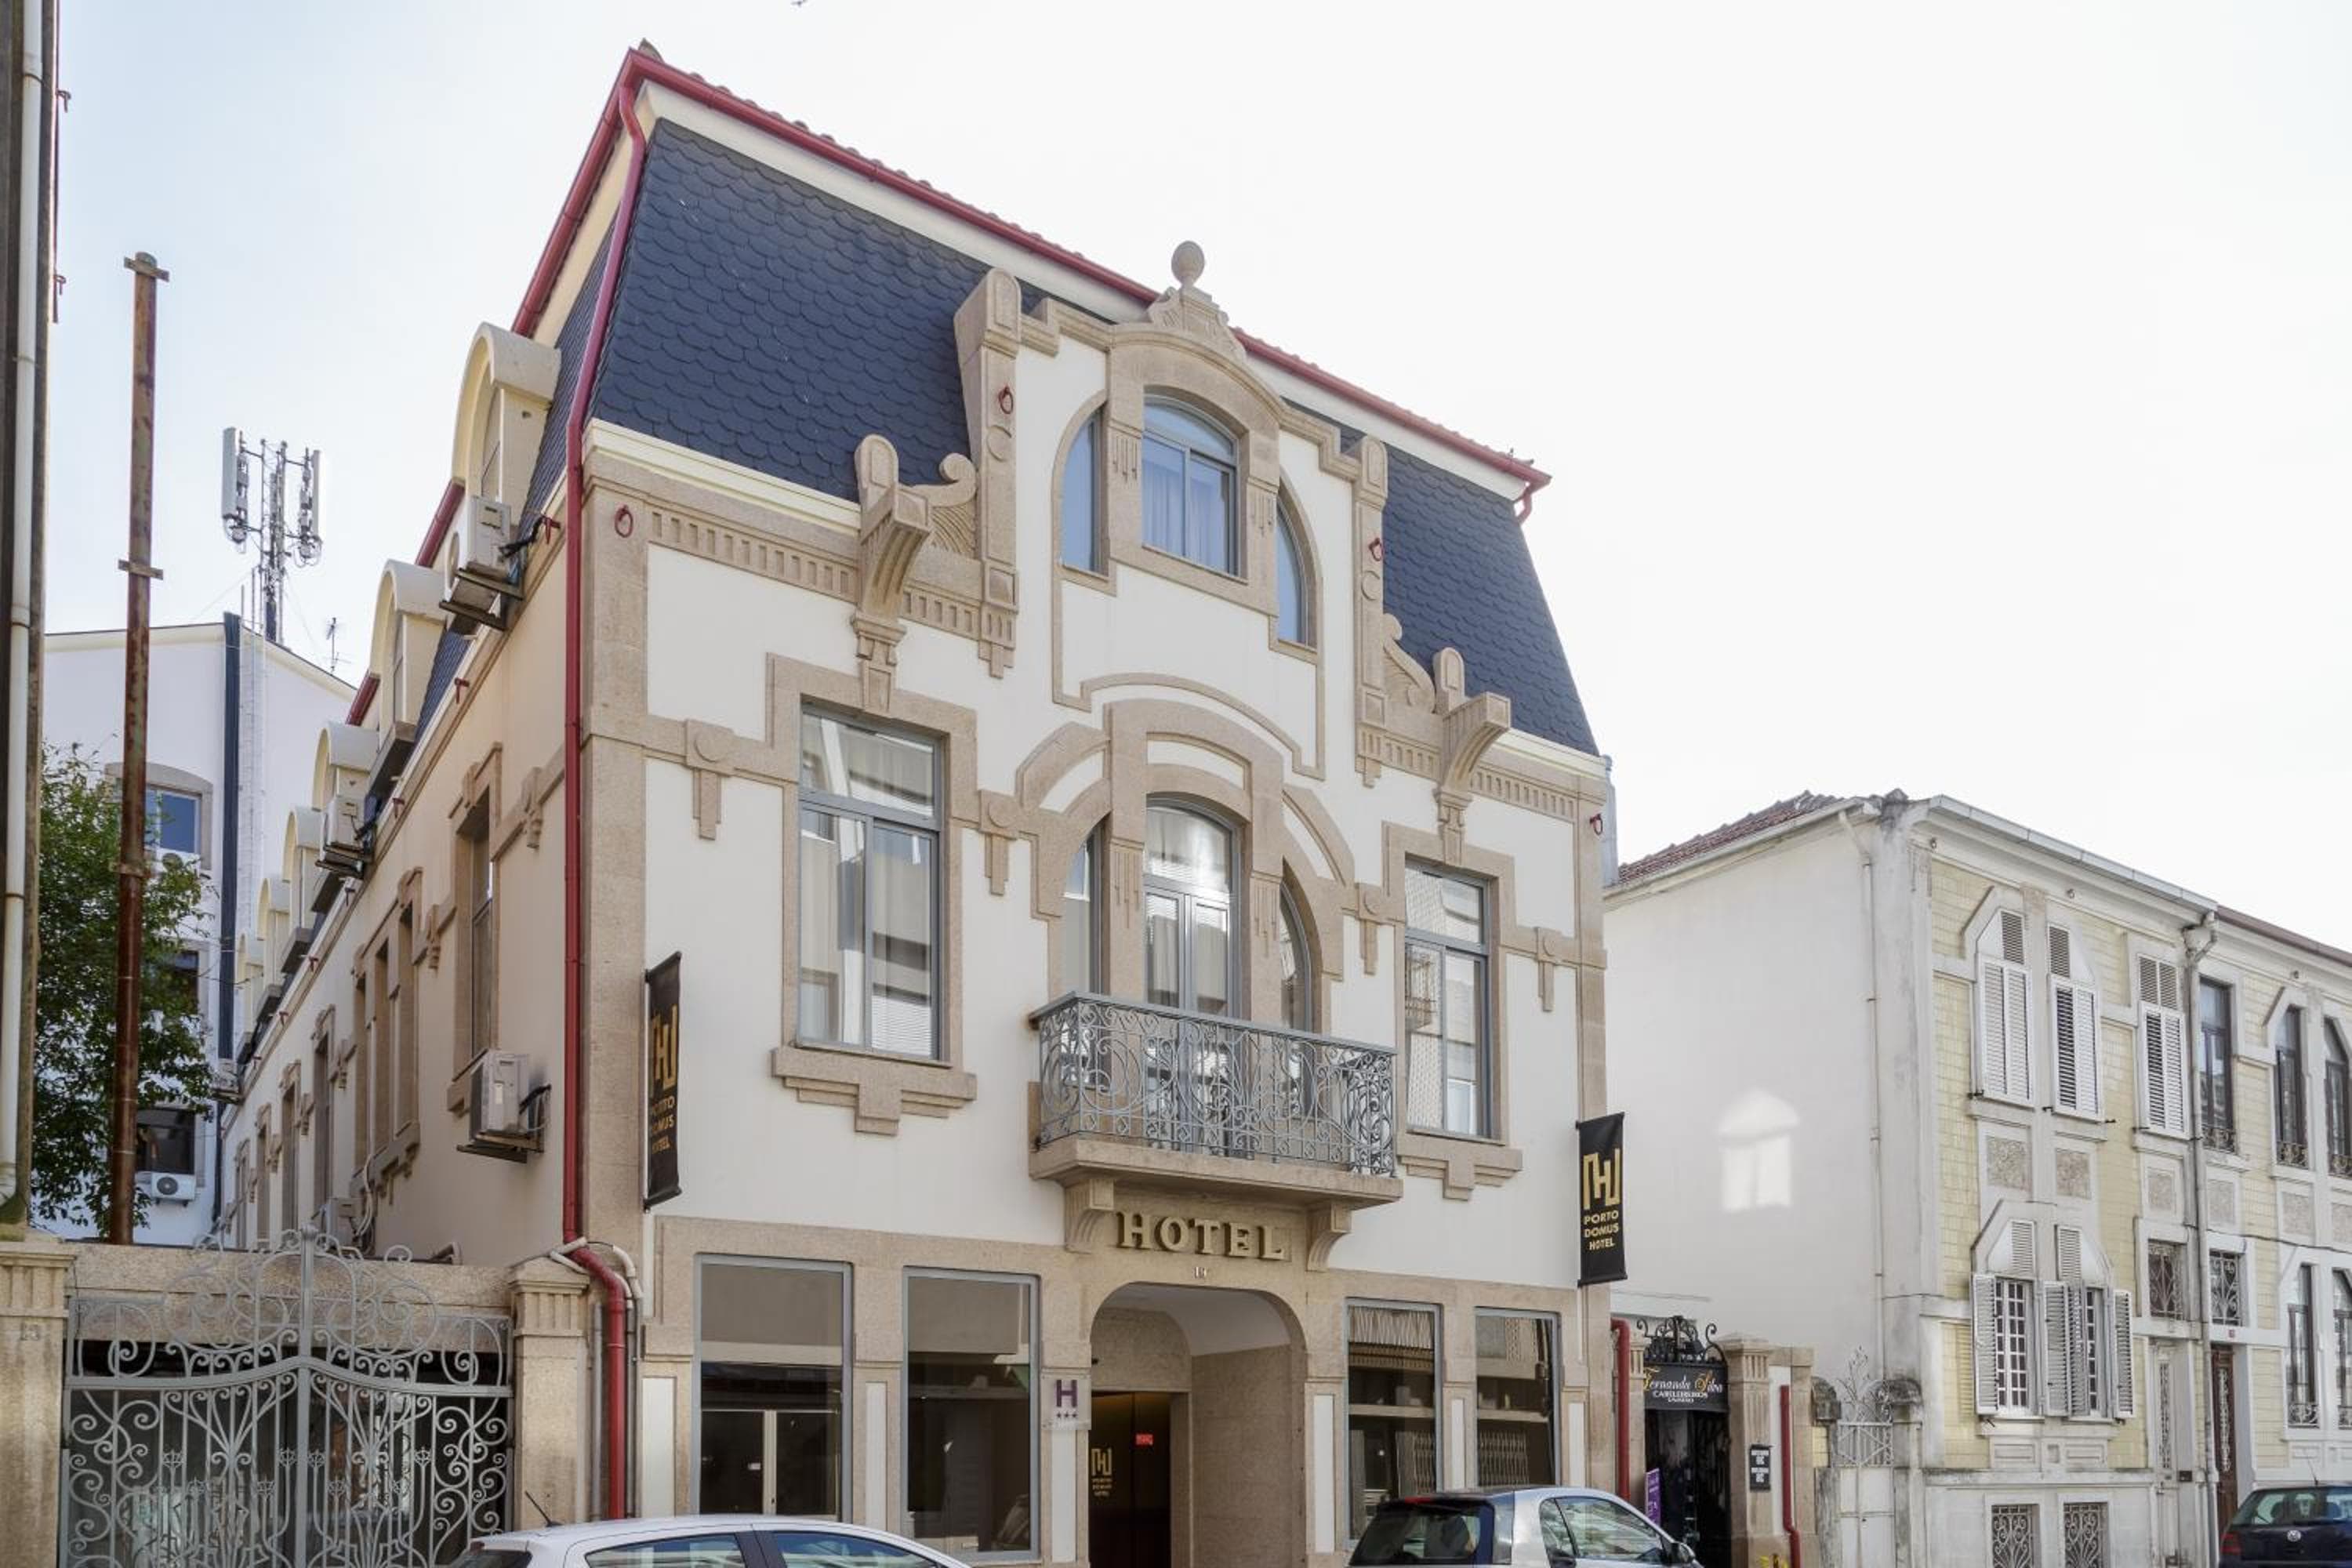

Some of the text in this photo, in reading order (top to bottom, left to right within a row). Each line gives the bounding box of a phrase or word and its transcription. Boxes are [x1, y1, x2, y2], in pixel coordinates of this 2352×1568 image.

[1584, 1210, 1619, 1225] PORTO
[1116, 1212, 1287, 1261] HOTEL
[1584, 1223, 1619, 1238] DOMUS
[1589, 1237, 1615, 1250] HOTEL
[1056, 1379, 1078, 1407] H
